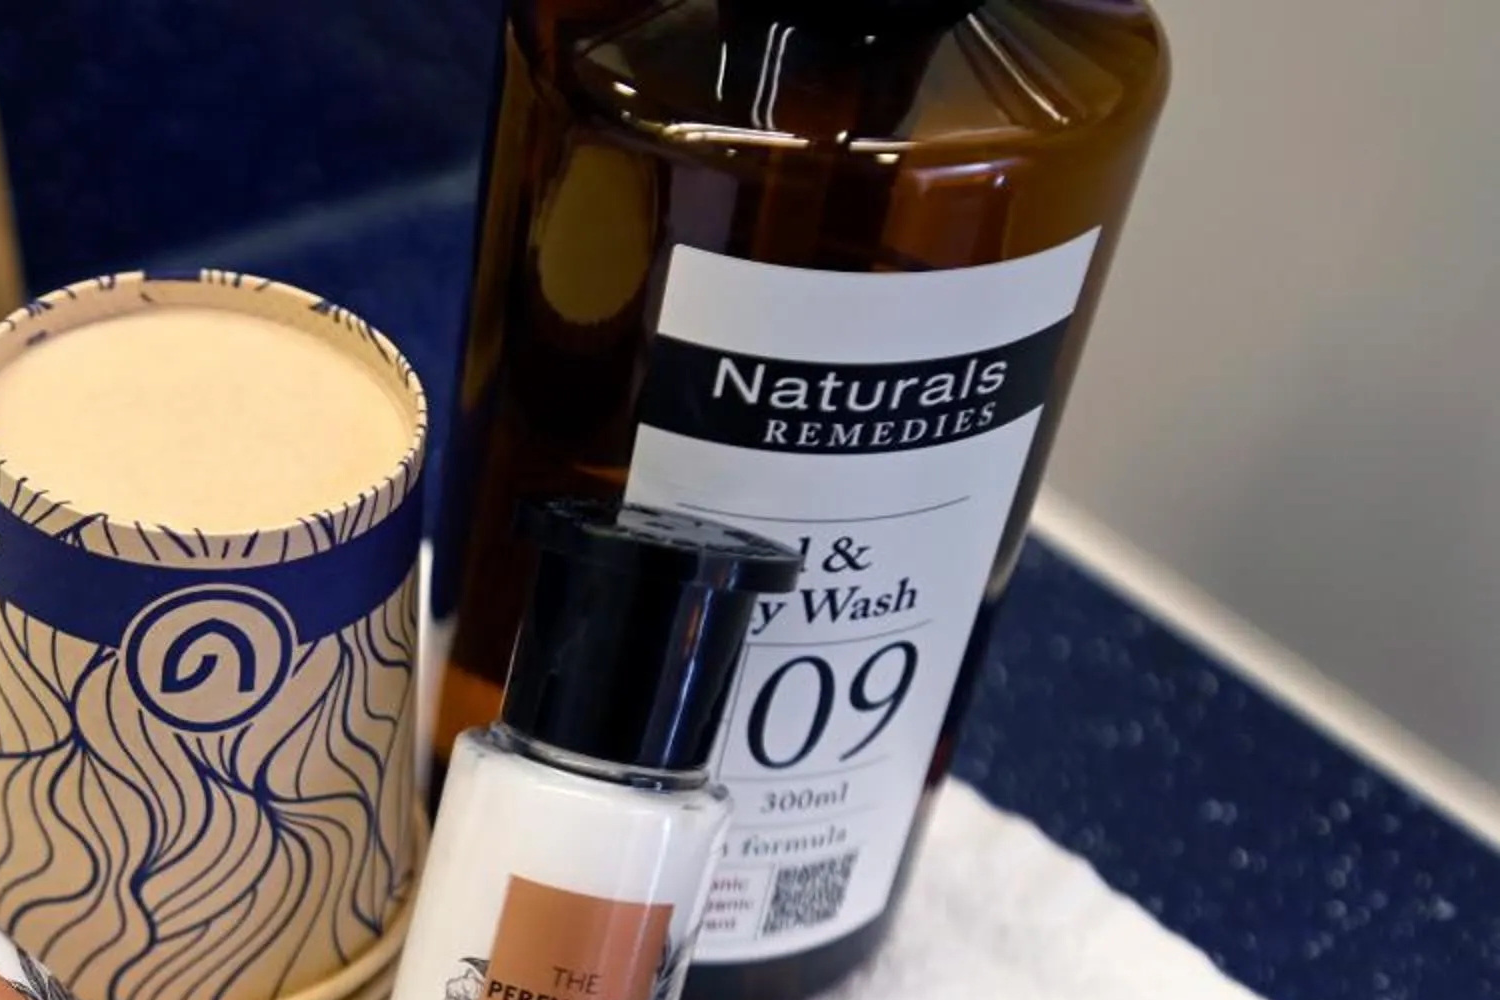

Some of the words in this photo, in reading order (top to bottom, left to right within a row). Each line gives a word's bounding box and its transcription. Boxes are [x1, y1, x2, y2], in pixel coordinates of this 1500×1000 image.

[711, 357, 1008, 412] Naturals
[762, 401, 997, 446] REMEDIES
[821, 536, 873, 573] &
[800, 577, 919, 624] Wash
[747, 640, 918, 769] 09
[760, 781, 849, 815] 300ml
[741, 825, 848, 858] formula
[553, 965, 603, 994] THE
